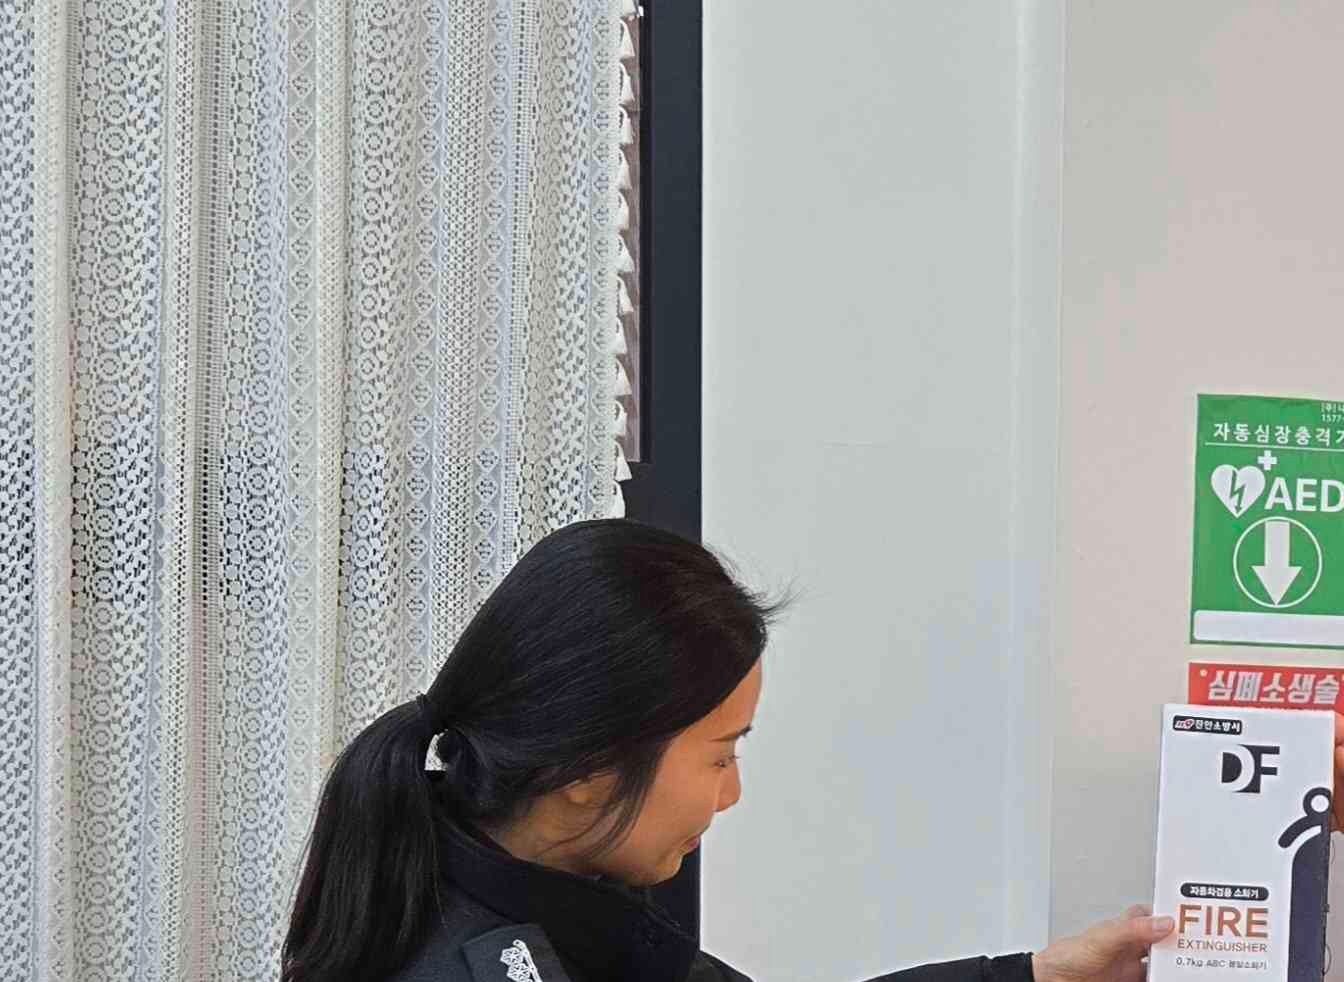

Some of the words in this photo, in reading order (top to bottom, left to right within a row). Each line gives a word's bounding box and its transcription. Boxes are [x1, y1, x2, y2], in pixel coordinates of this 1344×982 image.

[1208, 670, 1340, 705] 심폐소생술
[1220, 744, 1280, 793] DF
[1233, 888, 1259, 899] 소화기
[1179, 904, 1269, 938] FIRE
[1177, 938, 1268, 953] EXTINGUISHER
[1206, 959, 1226, 968] ABC
